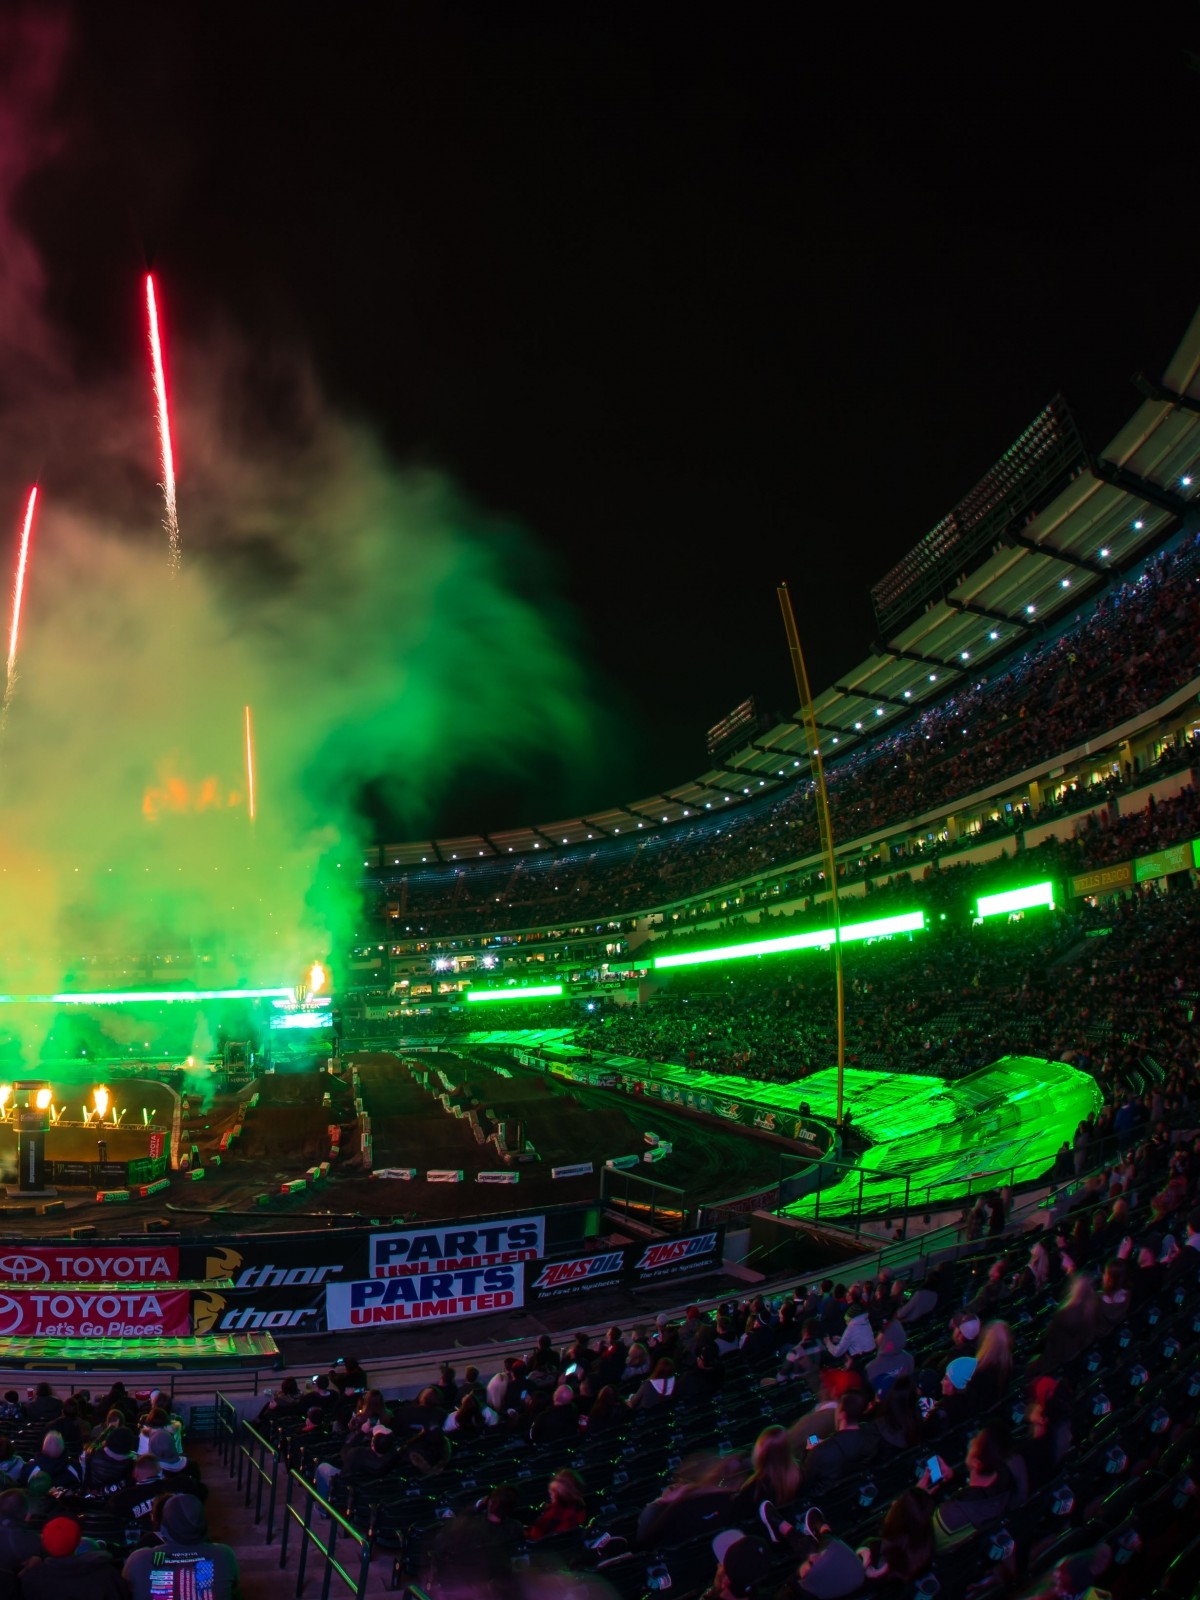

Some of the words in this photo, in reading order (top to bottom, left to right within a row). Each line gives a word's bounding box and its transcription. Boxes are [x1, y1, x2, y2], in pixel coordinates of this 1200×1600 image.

[375, 1223, 539, 1266] PARTS
[632, 1231, 719, 1271] AMSOIL
[55, 1256, 171, 1277] TOYOTA
[375, 1248, 538, 1279] UNLIMITED
[531, 1250, 625, 1290] AMSOIL
[639, 1272, 652, 1280] The
[653, 1268, 670, 1278] First
[679, 1259, 713, 1272] Synthetics
[234, 1264, 344, 1288] thor
[350, 1265, 516, 1308] PARTS
[538, 1290, 552, 1299] The
[553, 1287, 571, 1297] First
[581, 1279, 621, 1292] Synthetics
[30, 1295, 164, 1318] TOYOTA
[219, 1307, 318, 1330] thor
[350, 1290, 514, 1326] UNLIMITED
[35, 1322, 75, 1336] Let's
[79, 1322, 104, 1336] Go
[107, 1321, 164, 1336] Places
